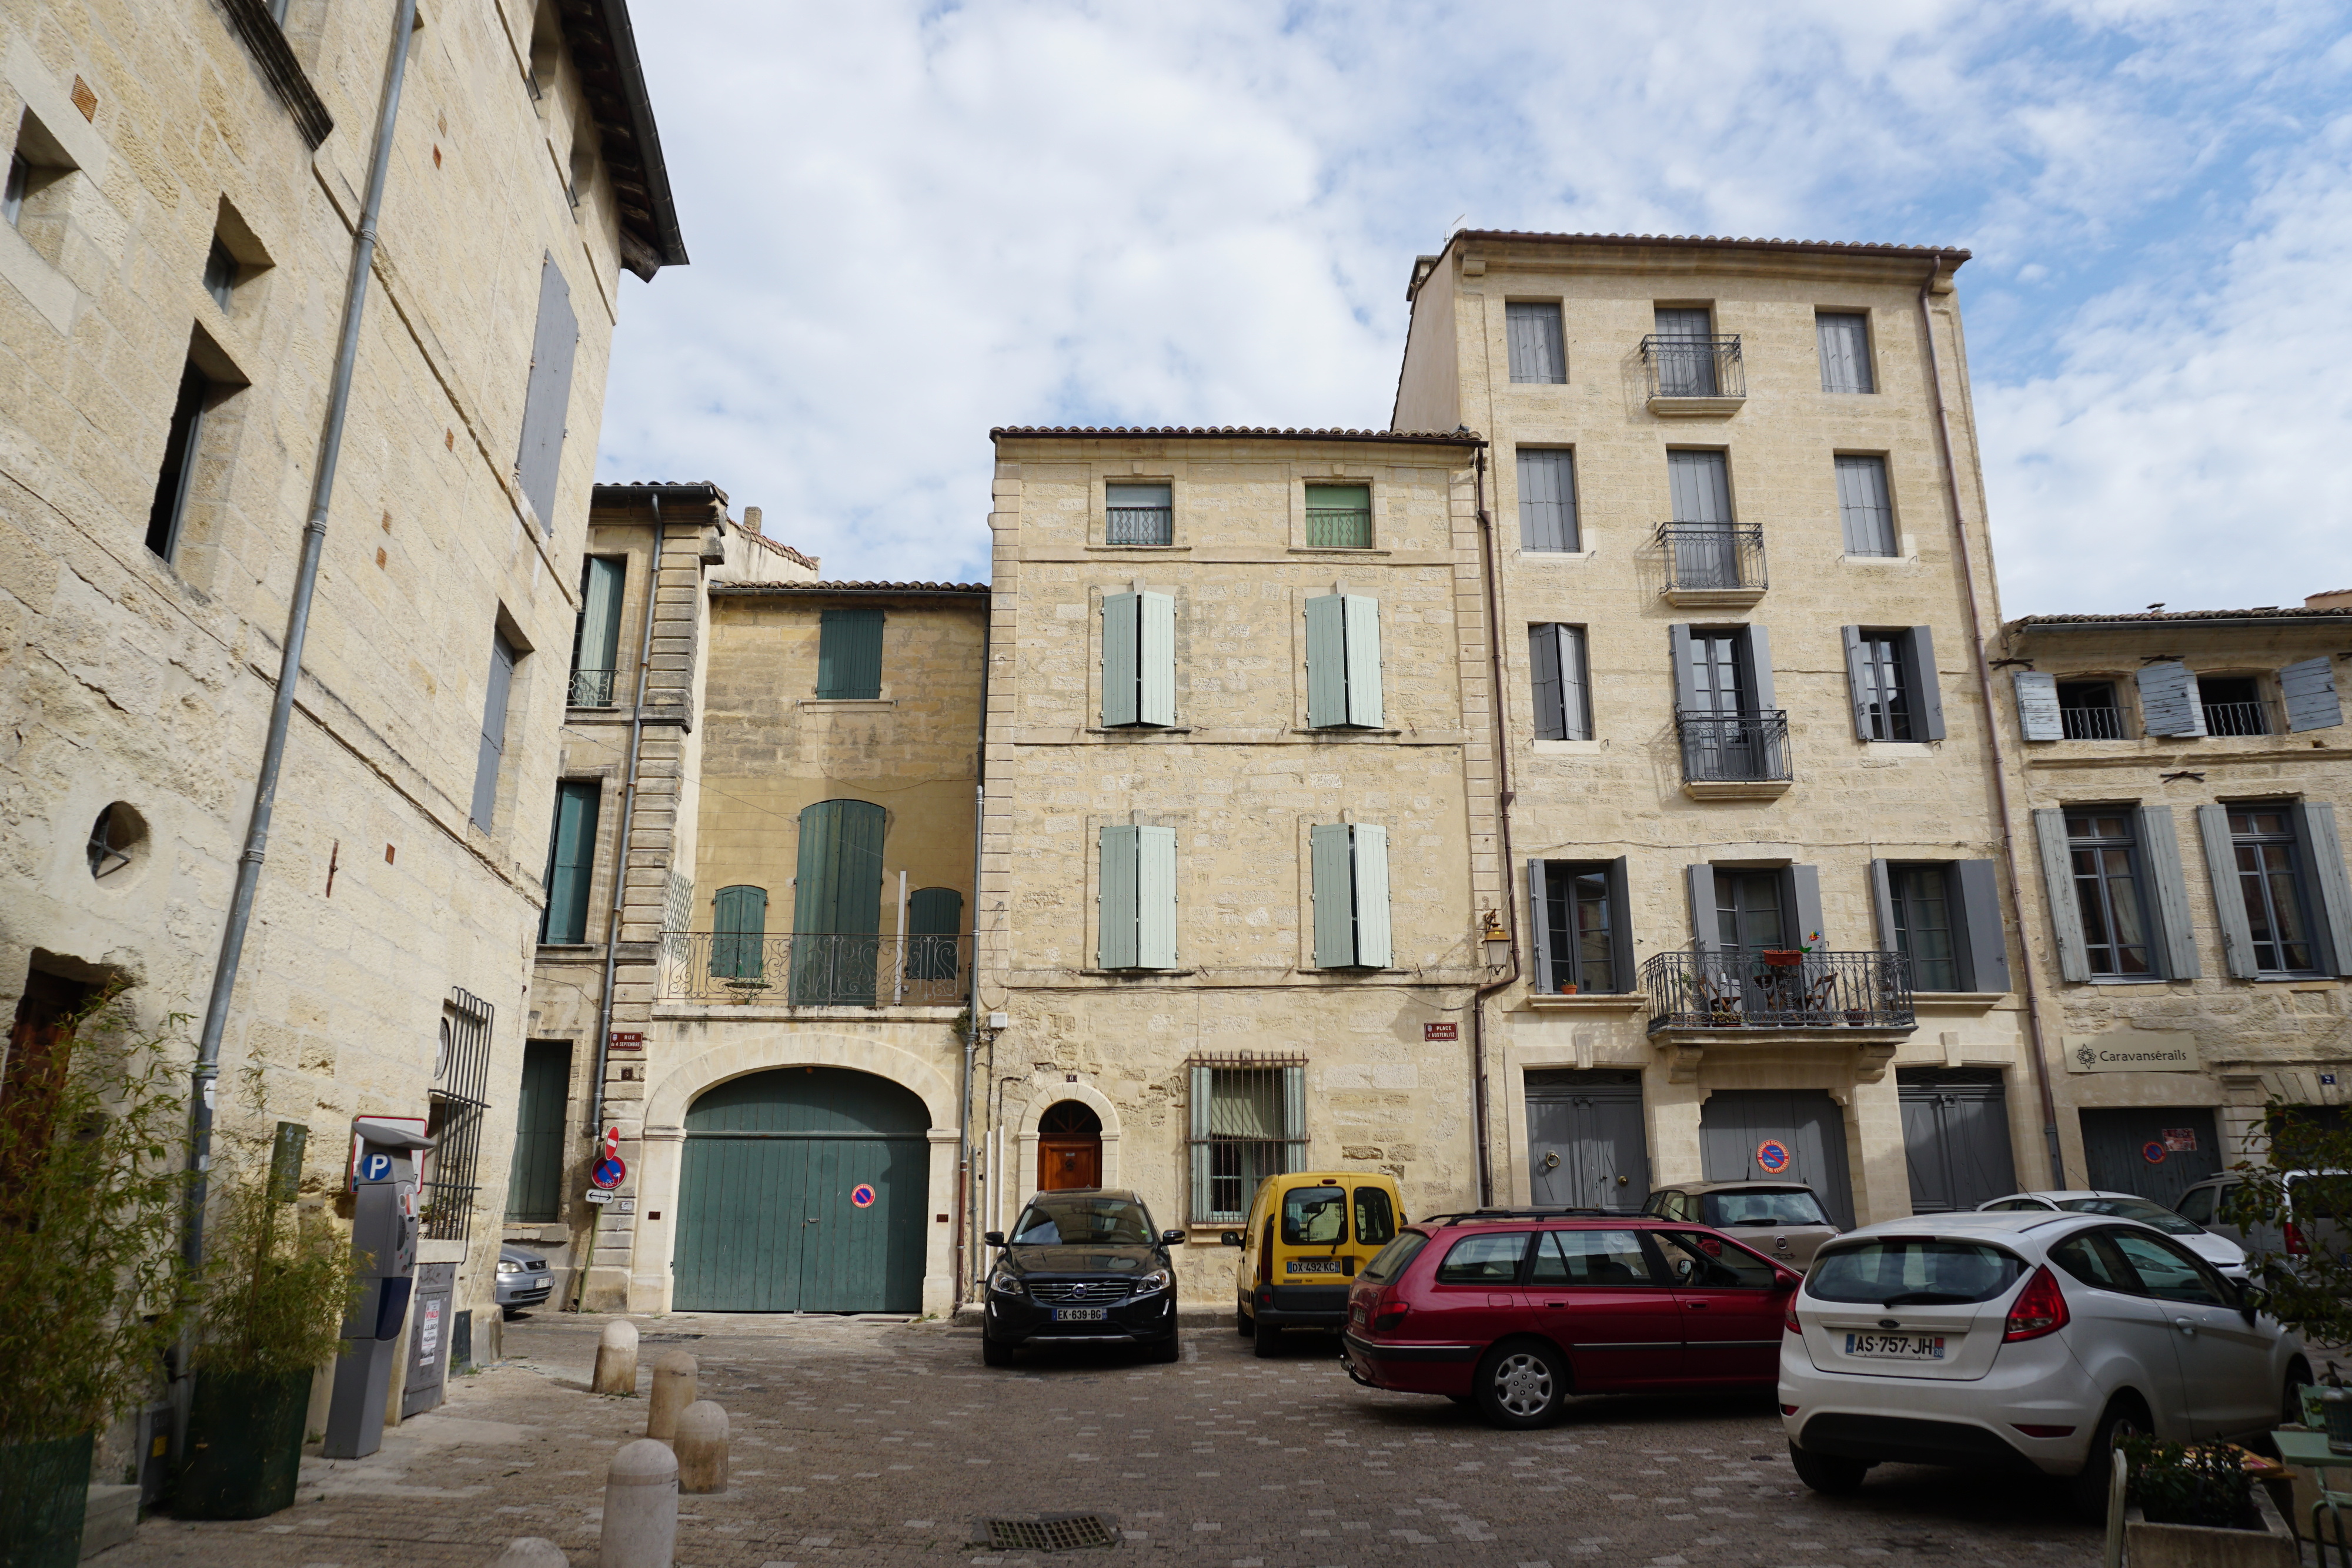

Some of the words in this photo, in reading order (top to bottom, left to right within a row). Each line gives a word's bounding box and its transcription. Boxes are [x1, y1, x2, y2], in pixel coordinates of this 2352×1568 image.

[2100, 1049, 2187, 1061] Caravansérails
[369, 1154, 388, 1179] P
[426, 1310, 439, 1319] VIVALDI
[1856, 1336, 1933, 1355] AS-757-JH
[1935, 1348, 1943, 1356] 30
